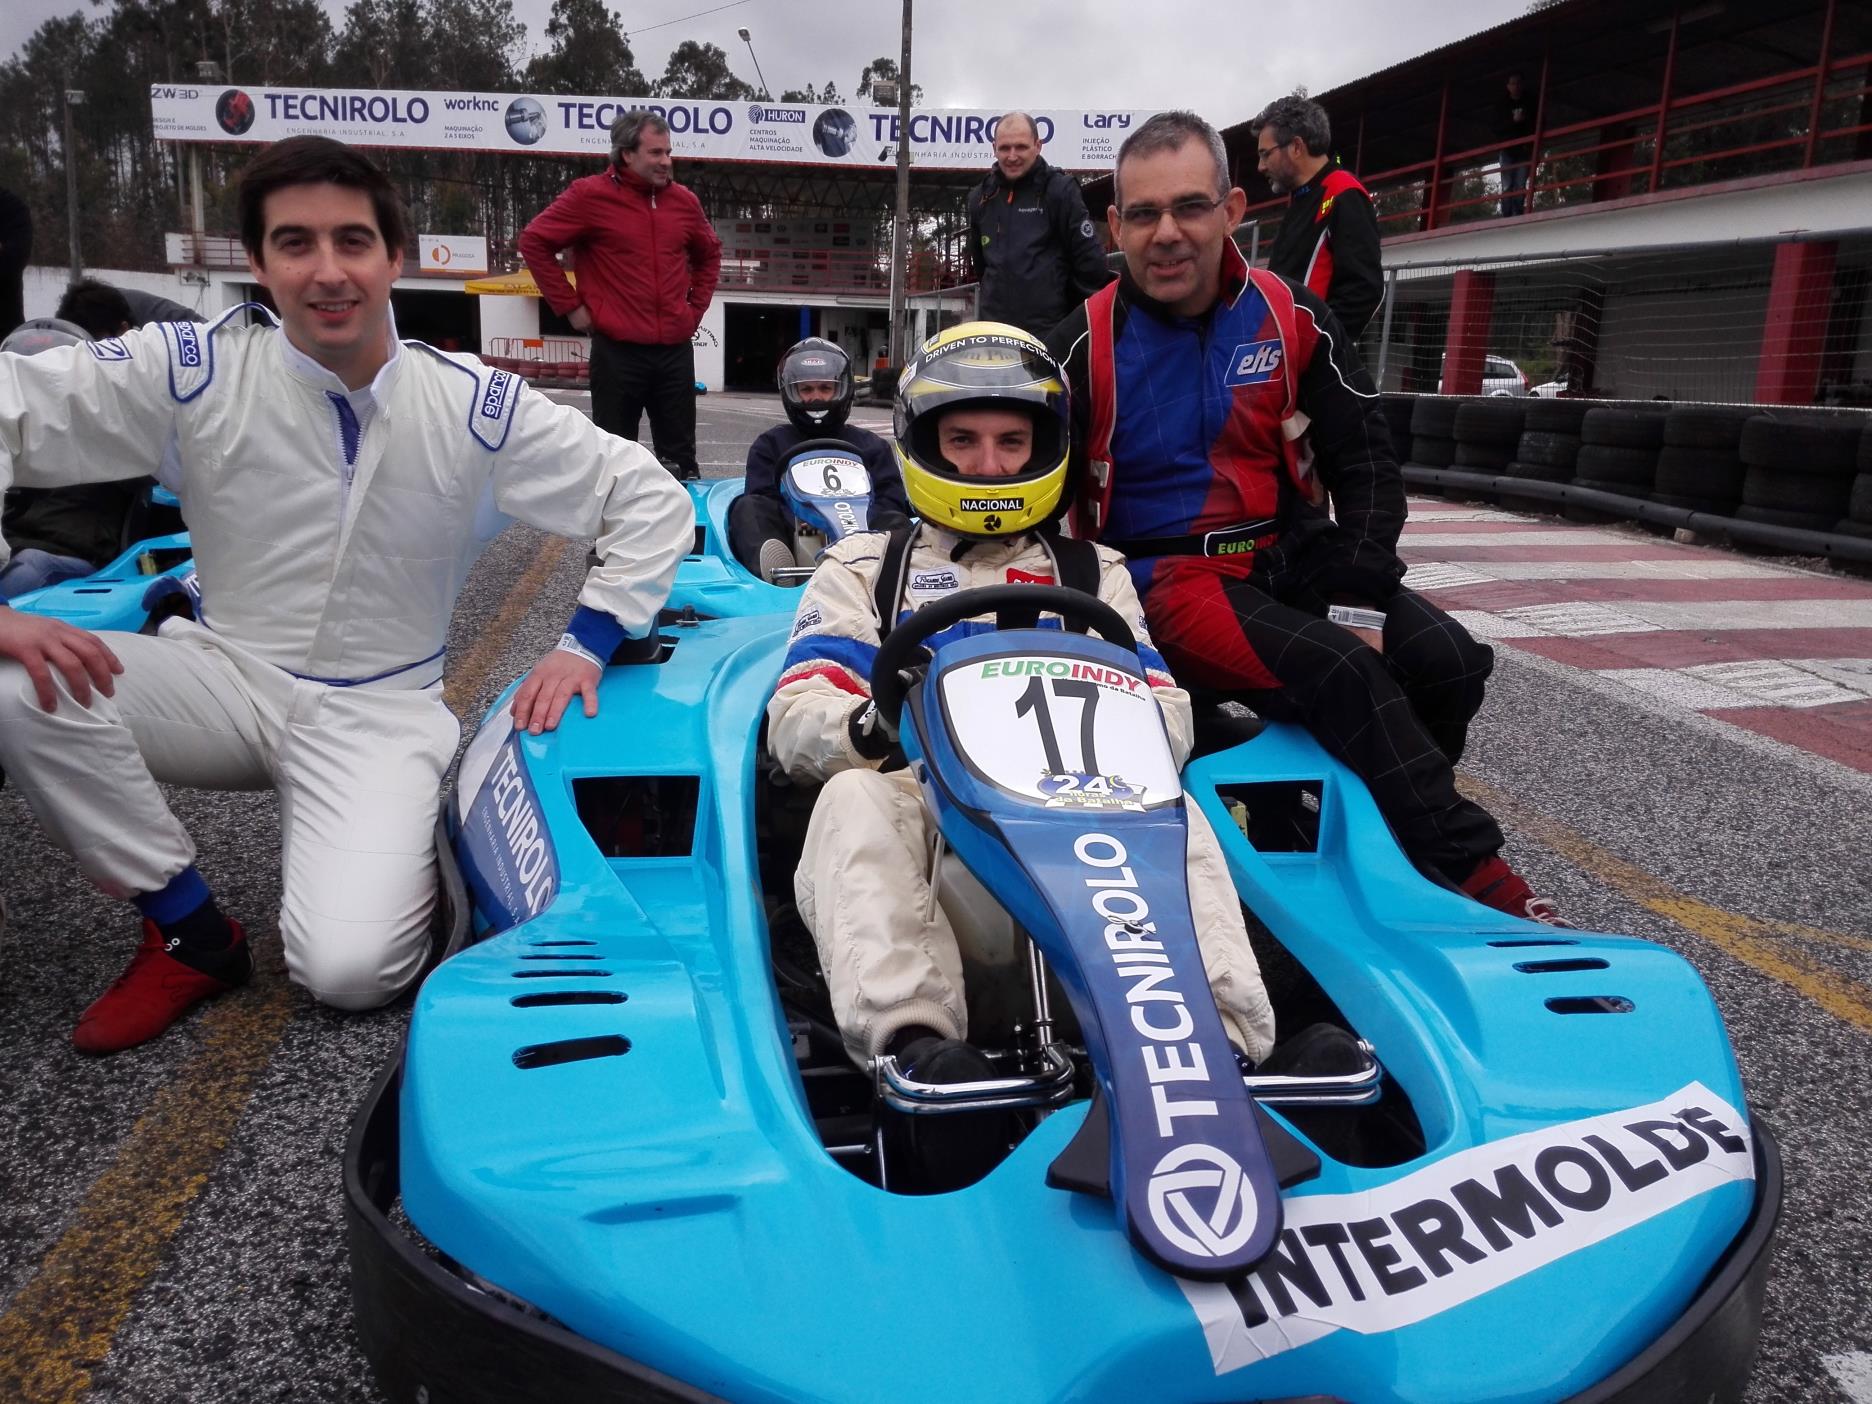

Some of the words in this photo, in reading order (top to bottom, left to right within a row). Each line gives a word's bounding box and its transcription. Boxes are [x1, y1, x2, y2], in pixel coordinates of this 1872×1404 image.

[264, 93, 430, 124] TECNIROLO
[443, 96, 499, 111] worknc
[767, 111, 803, 122] HURON
[444, 125, 483, 133] MAQUINAÇÃO
[557, 102, 733, 135] TECOLO
[749, 137, 791, 145] MAQUINAÇÃO
[1082, 137, 1110, 145] INJEÇÃO
[925, 336, 967, 364] DRIVEN
[970, 335, 988, 344] TO
[991, 336, 1058, 368] PERFECTION
[802, 458, 859, 467] EUROINDY
[822, 464, 842, 492] 6
[961, 499, 1023, 511] NACIONAL
[980, 660, 1143, 692] EUROINDY
[1015, 676, 1101, 776] 17
[1052, 775, 1113, 795] 24
[482, 805, 500, 856] ENGENHARIA
[491, 744, 556, 916] TECNIROLO
[1073, 832, 1219, 1138] TECNIROLO
[1225, 1106, 1748, 1329] INTERMOLDE
